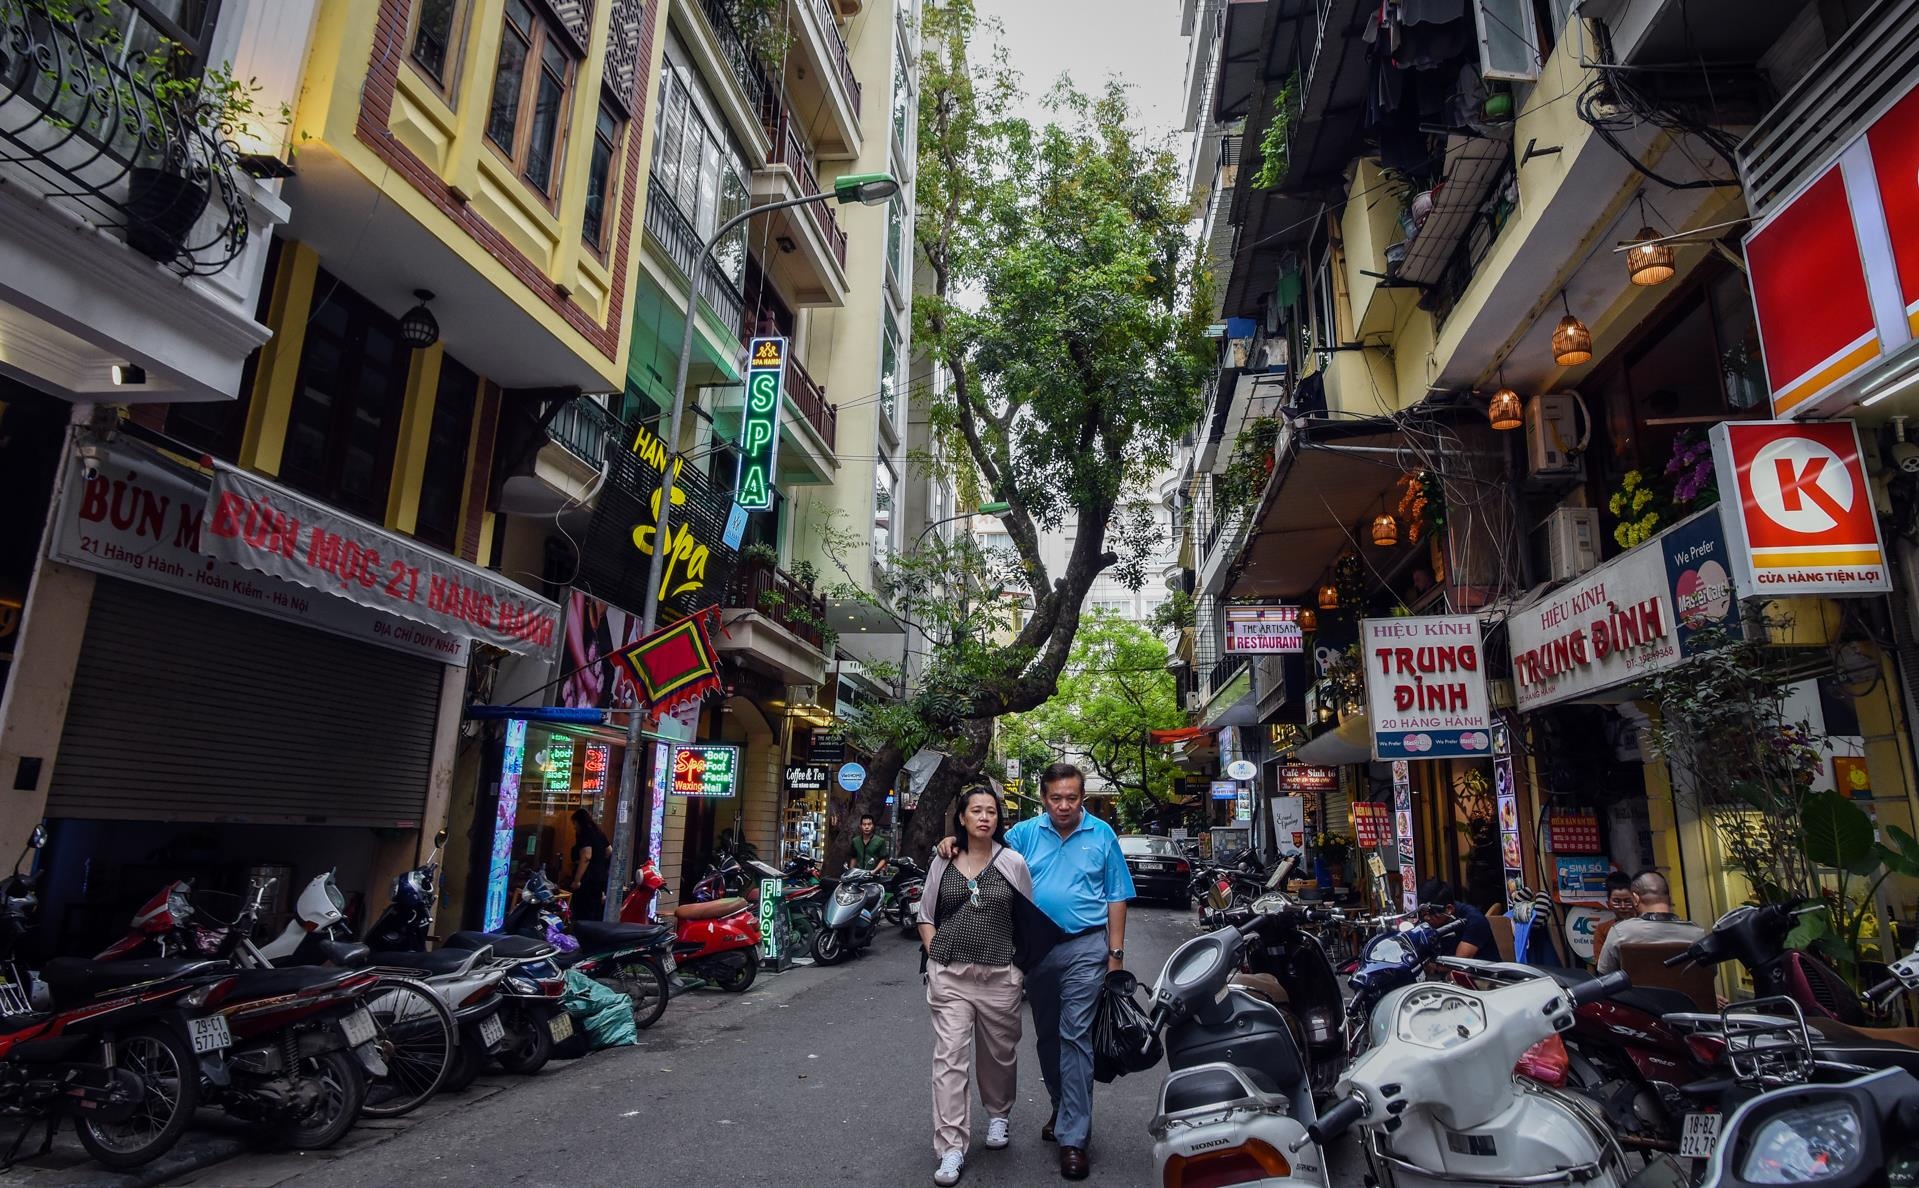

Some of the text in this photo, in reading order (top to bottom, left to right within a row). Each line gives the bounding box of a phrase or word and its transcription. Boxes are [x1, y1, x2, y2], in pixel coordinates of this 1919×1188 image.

[740, 375, 776, 504] SPA
[1774, 456, 1850, 528] K
[79, 471, 169, 540] BÚN
[80, 536, 98, 554] 21
[104, 542, 144, 569] Hàng
[147, 555, 185, 578] Hành
[210, 490, 299, 560] BÚN
[306, 527, 380, 590] MỌC
[385, 560, 420, 603] 21
[427, 569, 494, 628] HÀNG
[1674, 540, 1715, 567] We Prefer
[1757, 569, 1881, 584] CỬA HÀNG TIỆN LỢI
[1540, 583, 1608, 631] HIỆU KÍNH
[1242, 623, 1297, 634] THE ARTISAN
[1373, 621, 1472, 639] HIỆU KÍNH
[413, 633, 436, 646] DUY
[1238, 636, 1303, 649] RESTAURANT
[1514, 596, 1668, 688] TRUNG ĐỈNH
[1376, 645, 1477, 676] TRUNG
[1394, 675, 1468, 713] ĐỈNH
[1382, 715, 1483, 729] 20 HÀNG HÀNH
[705, 760, 727, 771] Foot
[707, 751, 729, 762] Body
[674, 750, 705, 782] Spa
[786, 768, 825, 784] Coffee & Tea
[674, 781, 703, 792] Waxing
[703, 783, 722, 792] Nail
[195, 1017, 223, 1034] 29-C1
[195, 1032, 230, 1051] 577.19
[1191, 1138, 1230, 1151] HONDA
